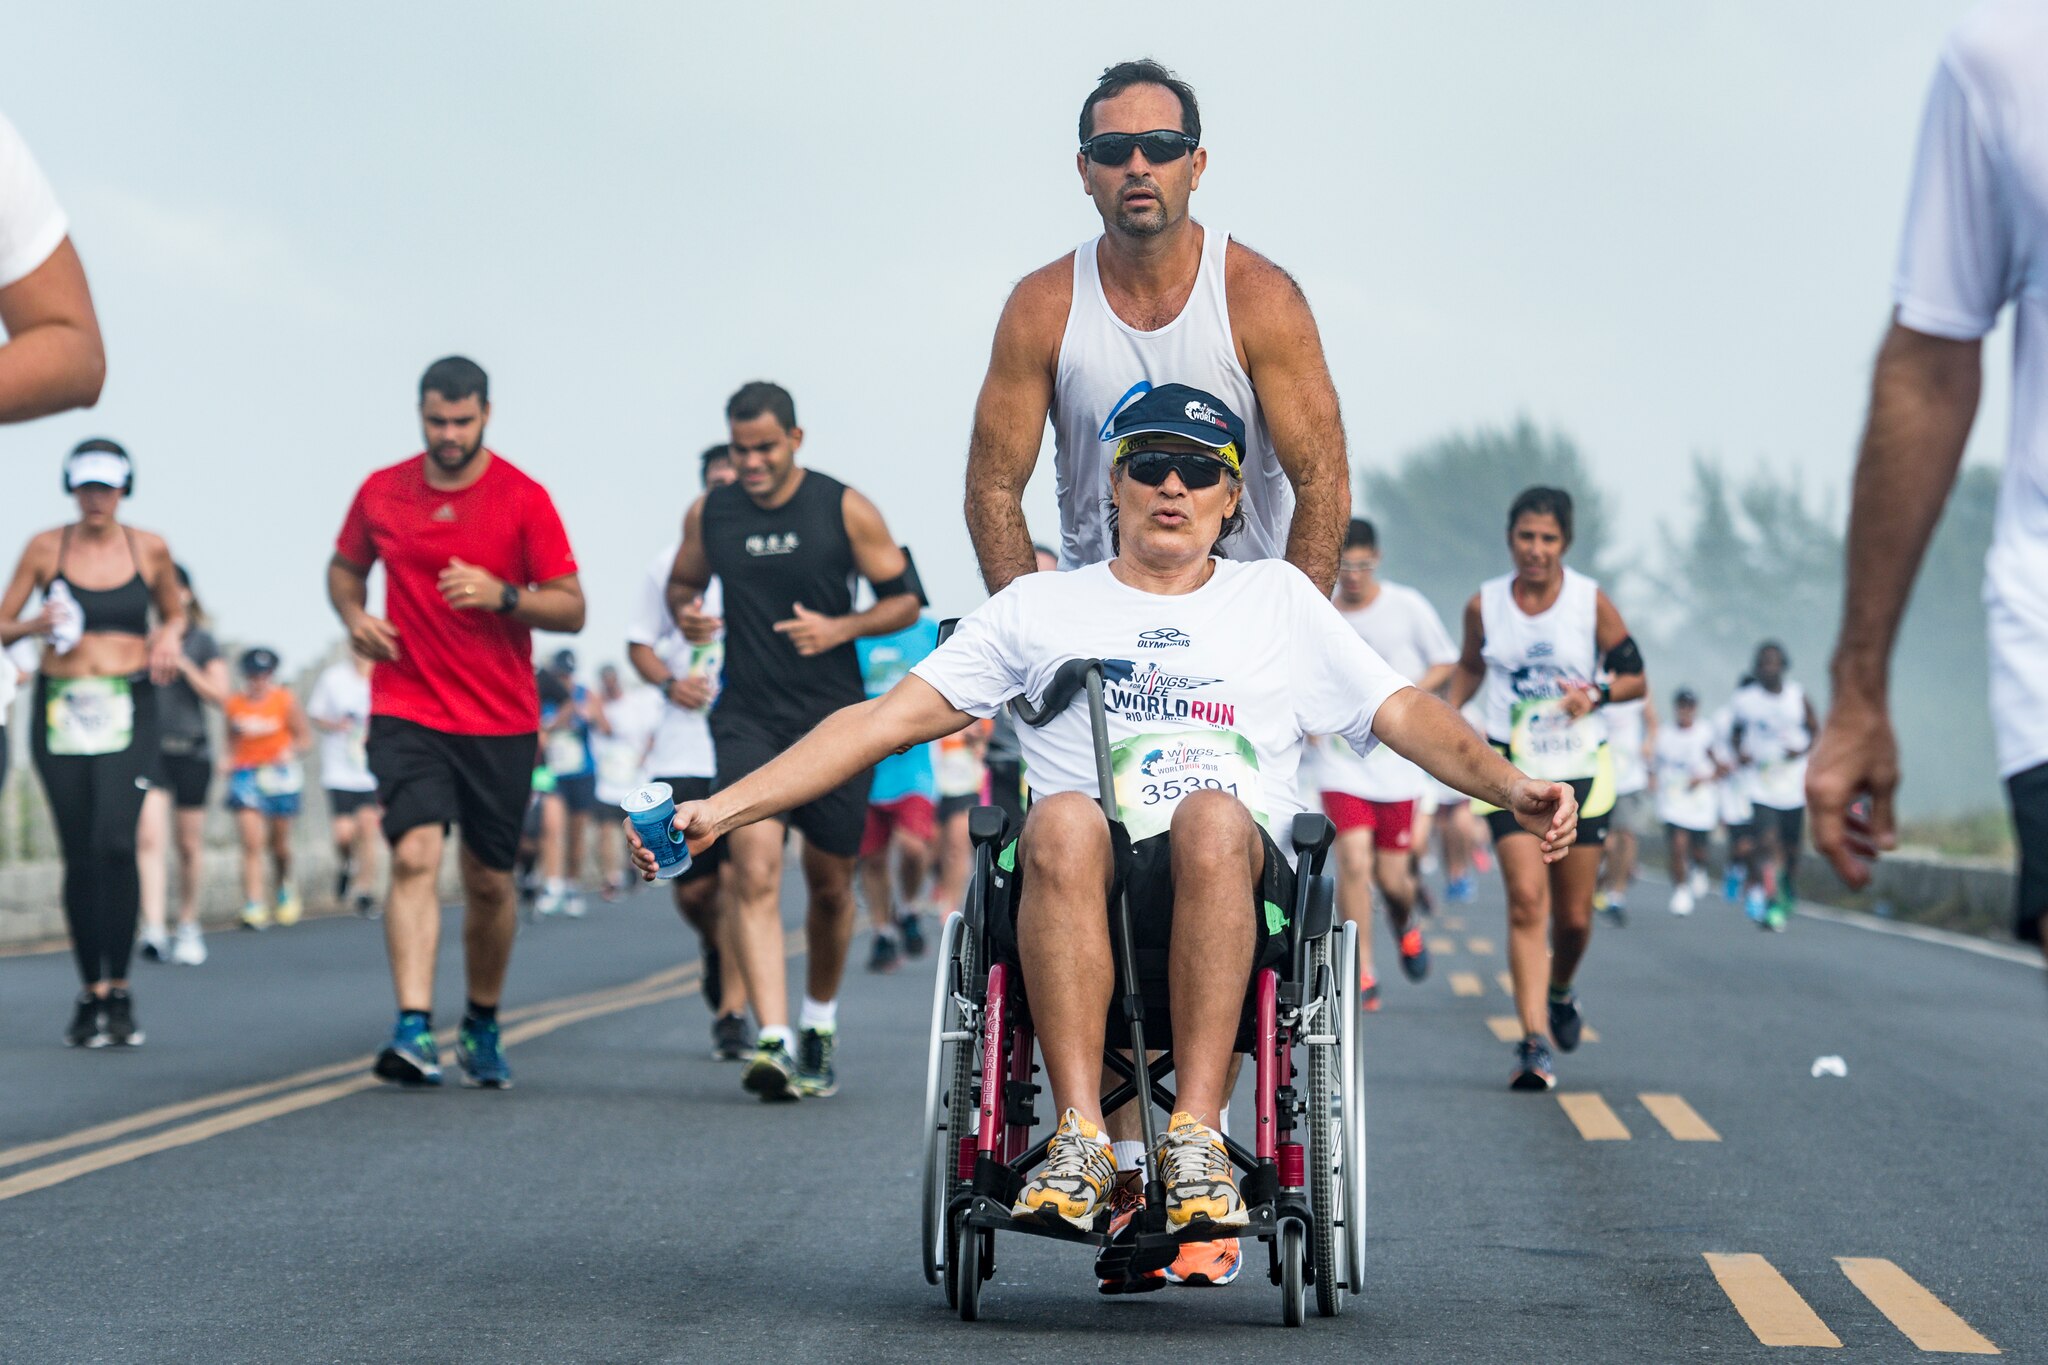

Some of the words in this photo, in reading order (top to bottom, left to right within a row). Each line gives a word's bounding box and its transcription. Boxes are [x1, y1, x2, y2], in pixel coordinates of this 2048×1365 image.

[1193, 411, 1216, 425] WORLD
[1134, 671, 1189, 688] WINGS
[1140, 685, 1172, 697] LIFE
[1111, 688, 1188, 717] WORLD
[1191, 700, 1235, 727] RUN
[1125, 712, 1143, 722] RIO
[1167, 746, 1214, 759] WINGS
[1175, 755, 1200, 765] LIFE
[1158, 764, 1184, 775] WORLD
[1201, 763, 1219, 772] 2018
